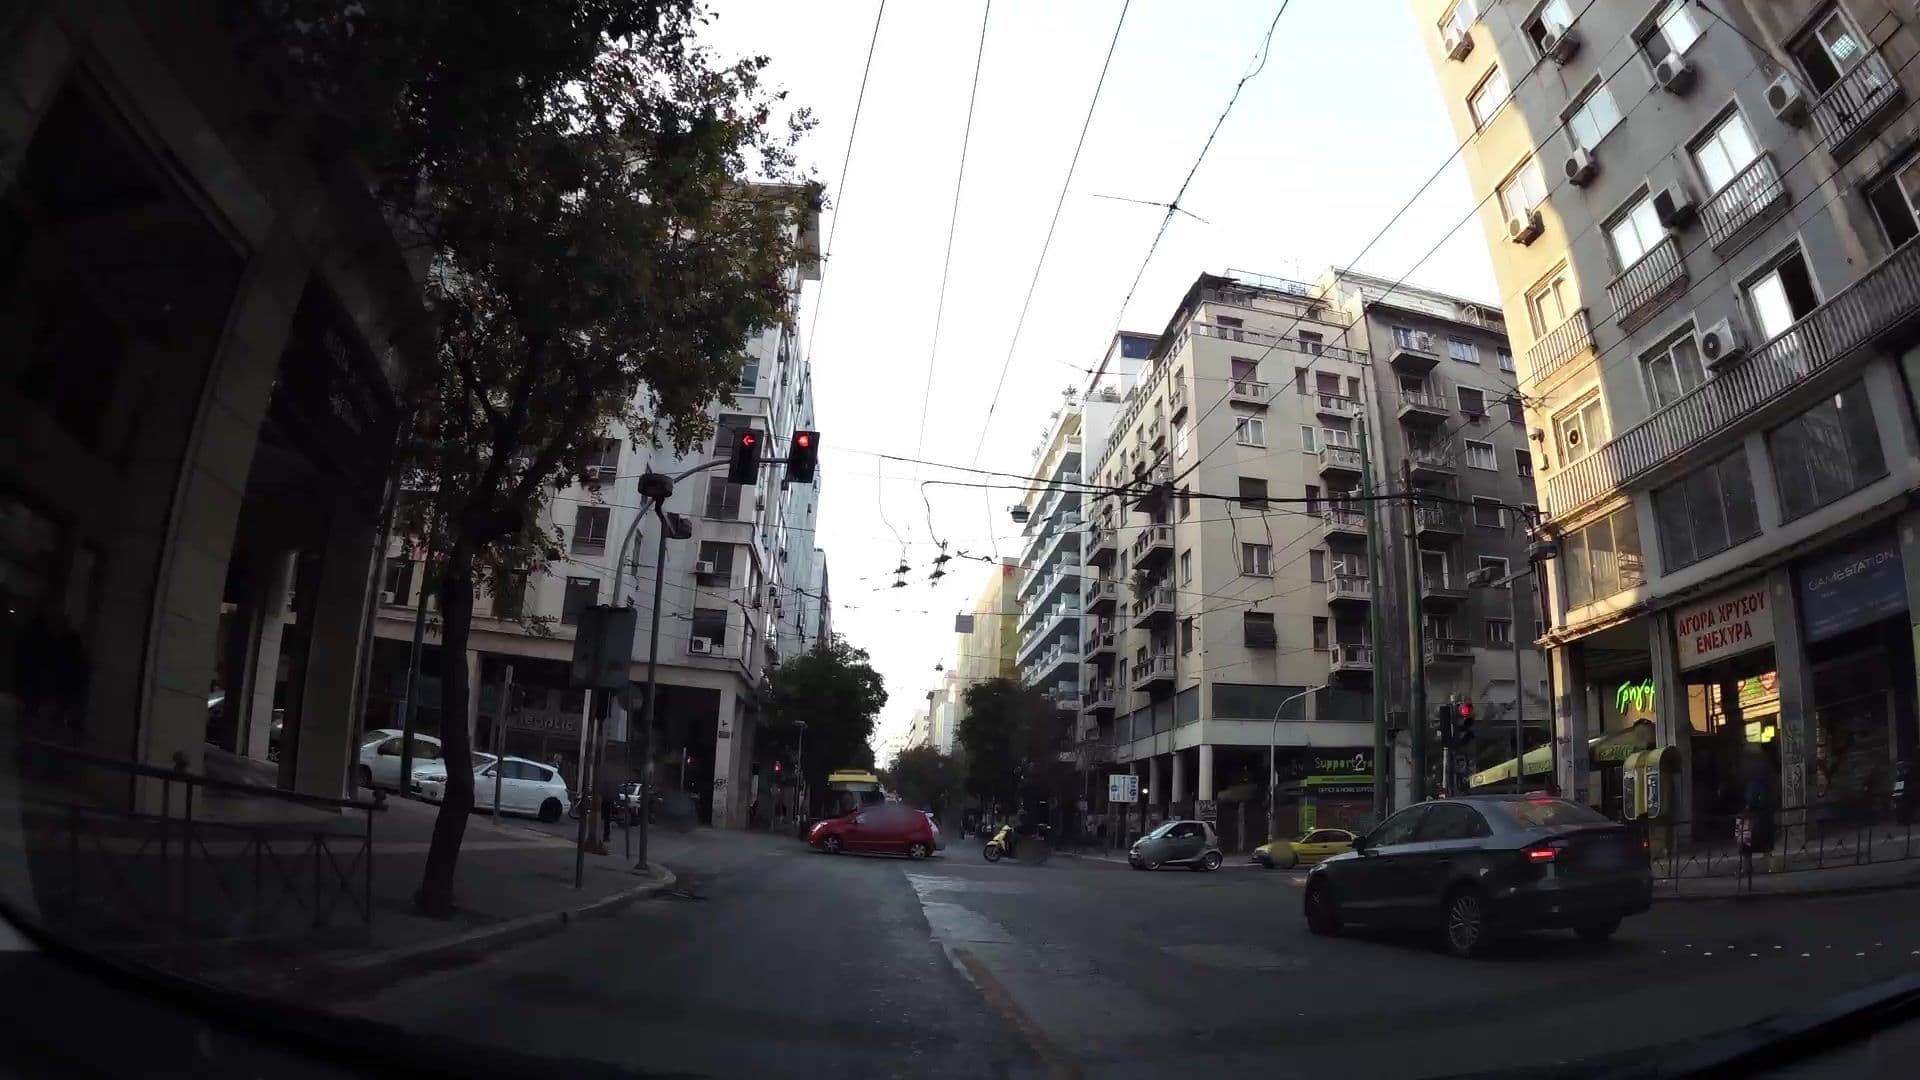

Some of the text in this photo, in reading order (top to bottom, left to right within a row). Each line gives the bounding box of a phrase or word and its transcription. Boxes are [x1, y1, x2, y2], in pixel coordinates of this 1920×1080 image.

[1679, 591, 1767, 637] ΑΓΟΡΑ ΧΡΥΣΟΥ
[1696, 620, 1753, 655] ΕΝΕΧΥΡΑ
